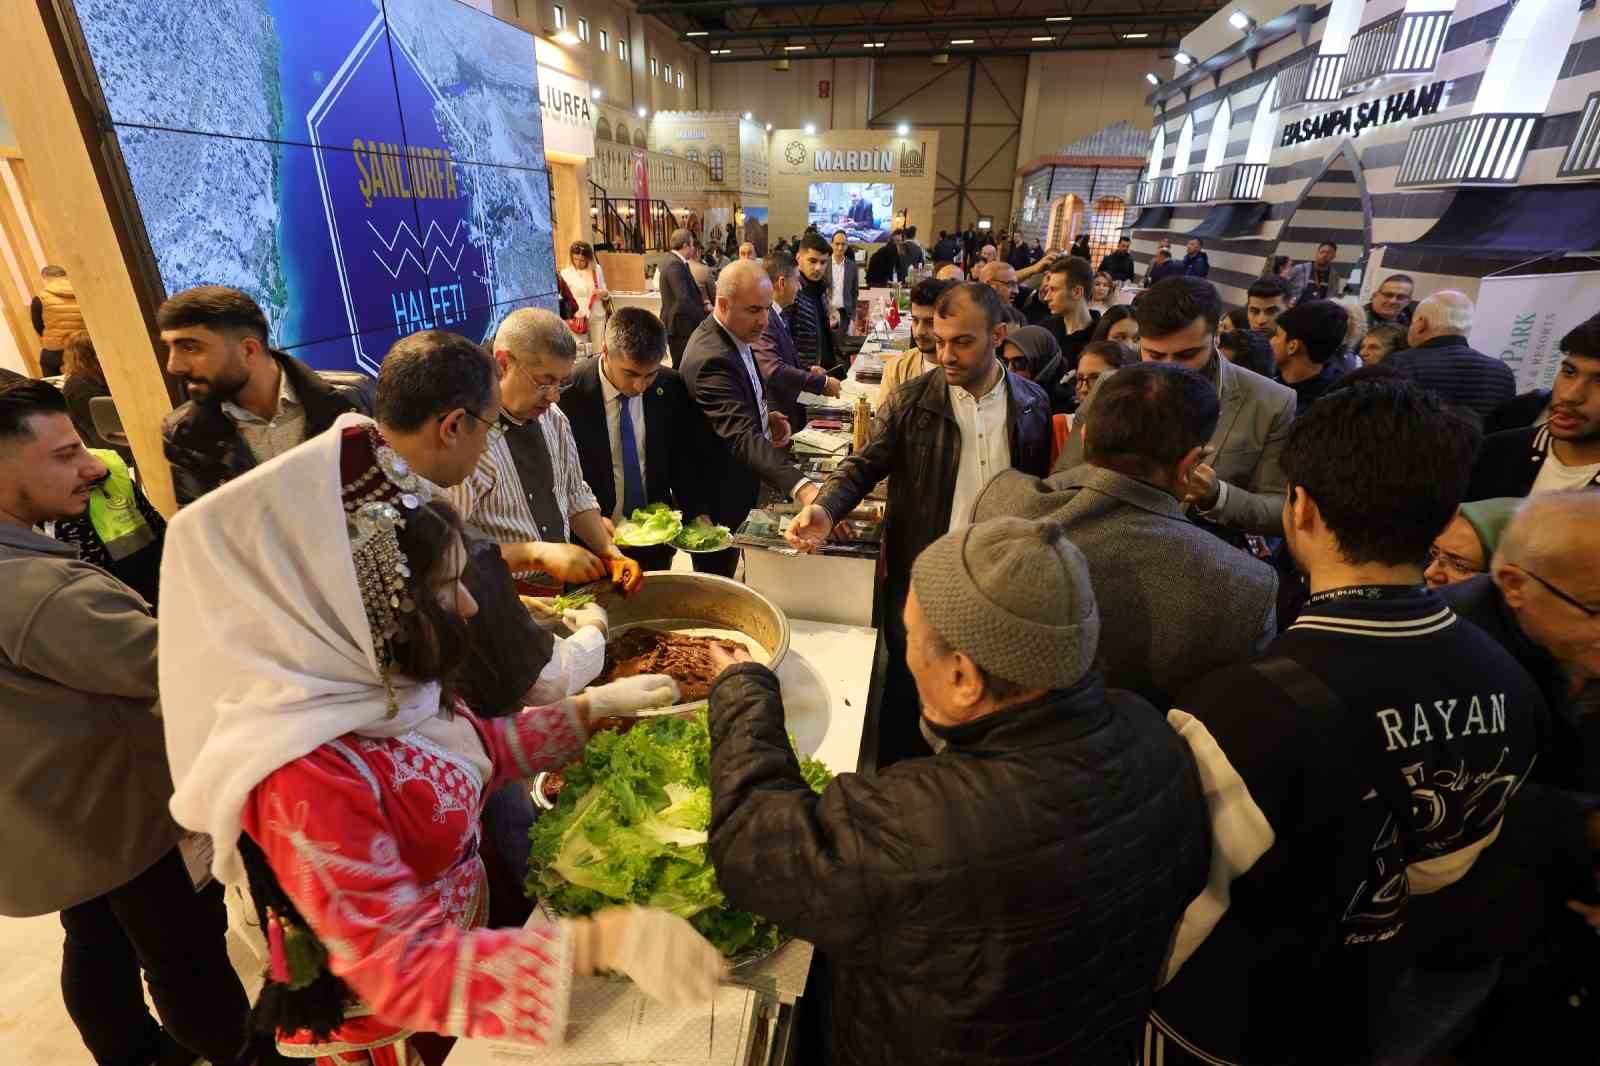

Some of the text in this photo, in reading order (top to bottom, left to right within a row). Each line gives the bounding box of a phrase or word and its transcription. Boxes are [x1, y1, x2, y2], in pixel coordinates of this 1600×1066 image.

[815, 145, 893, 172] MARDİN
[391, 275, 467, 335] HALFETİ
[1376, 692, 1505, 751] RAYAN
